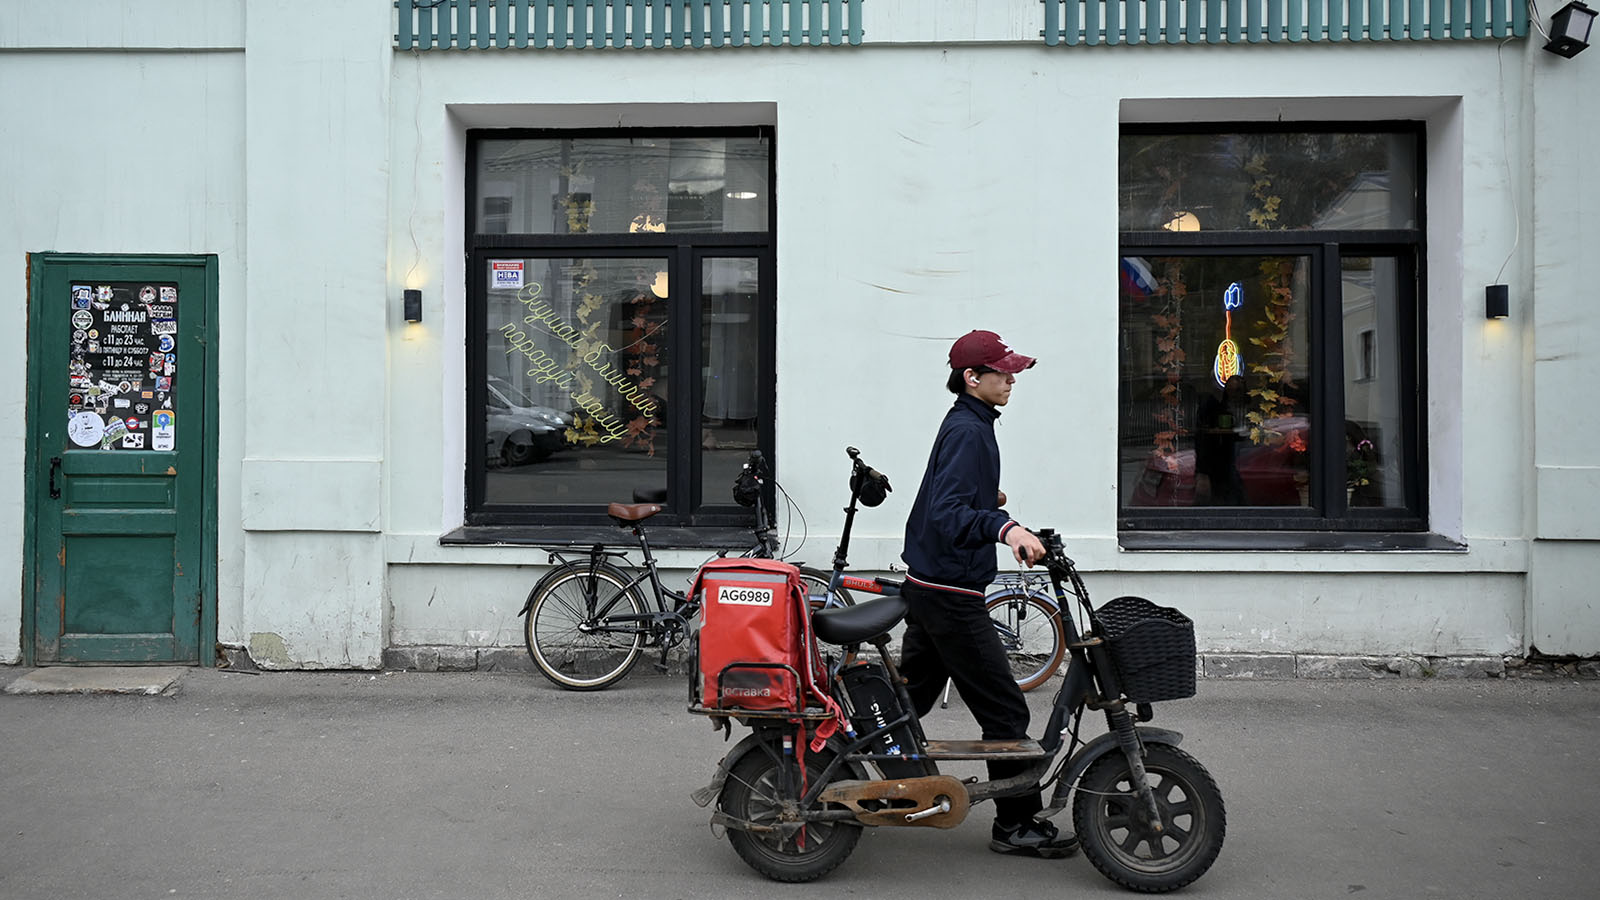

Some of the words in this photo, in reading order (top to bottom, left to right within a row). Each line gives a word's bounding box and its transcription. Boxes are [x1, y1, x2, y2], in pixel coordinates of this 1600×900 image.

[103, 310, 147, 323] БЛИННАЯ
[517, 281, 588, 350] Скушай
[110, 324, 139, 334] РАБОТАЕТ
[107, 334, 115, 345] 11
[124, 334, 134, 345] 23
[107, 355, 114, 367] 11
[123, 355, 133, 367] 24
[499, 322, 577, 389] порадуй
[570, 390, 629, 444] маму
[719, 588, 771, 603] AG6989
